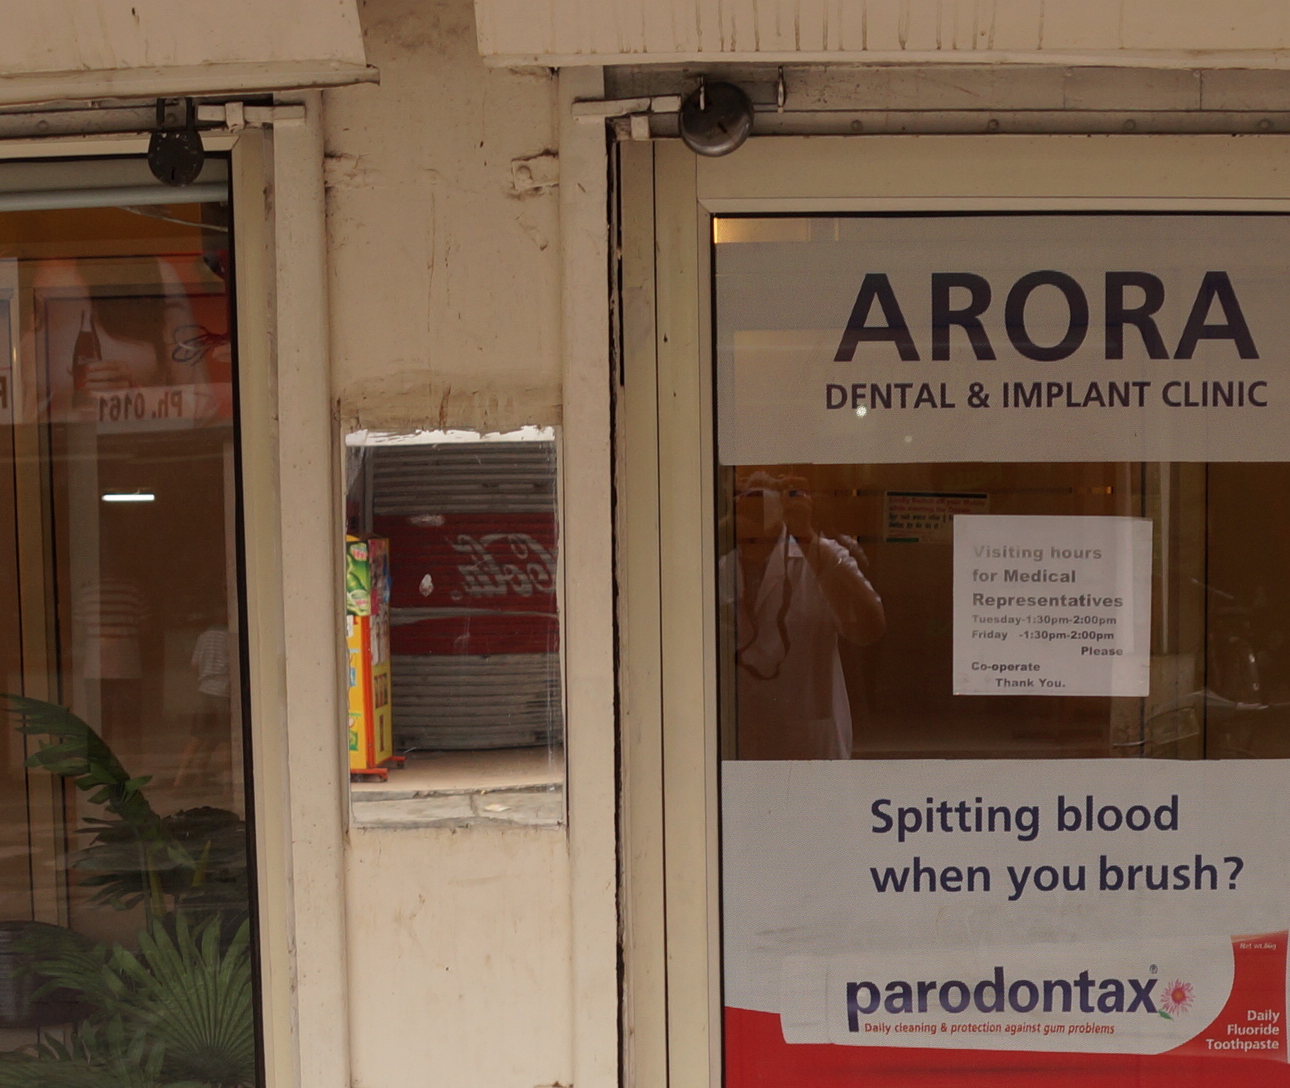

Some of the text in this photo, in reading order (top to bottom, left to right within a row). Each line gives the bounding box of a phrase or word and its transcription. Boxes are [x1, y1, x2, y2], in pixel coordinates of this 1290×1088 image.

[833, 268, 1260, 363] ARORA
[825, 380, 1269, 410] DENTAL & IMPLANT CLINIC
[972, 545, 1103, 562] Visiting hours
[972, 568, 1077, 584] for Medical
[972, 592, 1124, 610] Representatives
[971, 630, 1009, 642] Friday
[1080, 645, 1124, 657] Please
[970, 660, 1041, 674] Co-operate
[995, 677, 1066, 689] Thank You.
[871, 794, 1180, 843] Spitting blood
[870, 855, 1244, 901] when you brush?
[845, 965, 1159, 1034] parodontax
[1246, 1009, 1281, 1024] Daily
[864, 1022, 1115, 1036] Daily cleaning & protection against gum problems
[1226, 1023, 1280, 1037] Fluoride
[1205, 1037, 1280, 1053] Toothpaste
